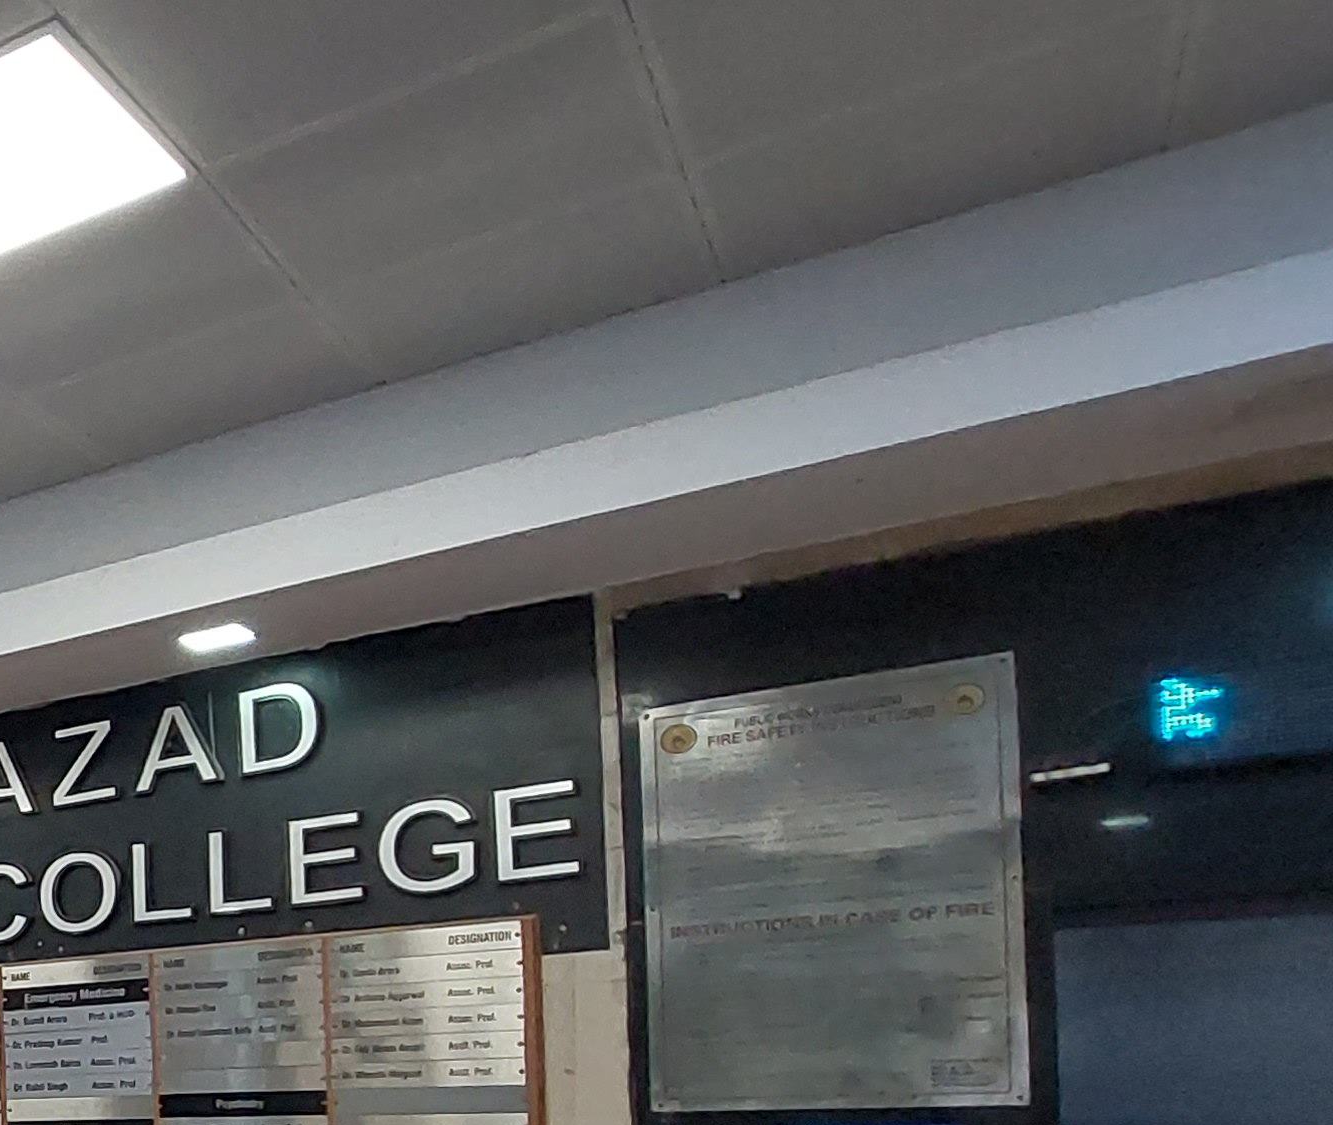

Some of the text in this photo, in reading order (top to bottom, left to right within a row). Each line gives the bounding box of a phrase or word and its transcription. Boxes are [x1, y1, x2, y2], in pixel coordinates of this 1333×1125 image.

[707, 731, 742, 748] FIRE
[909, 906, 937, 922] OF
[945, 902, 996, 918] FIRE
[448, 930, 512, 946] DESIGNATION
[24, 987, 125, 1004] Emergency Medicine
